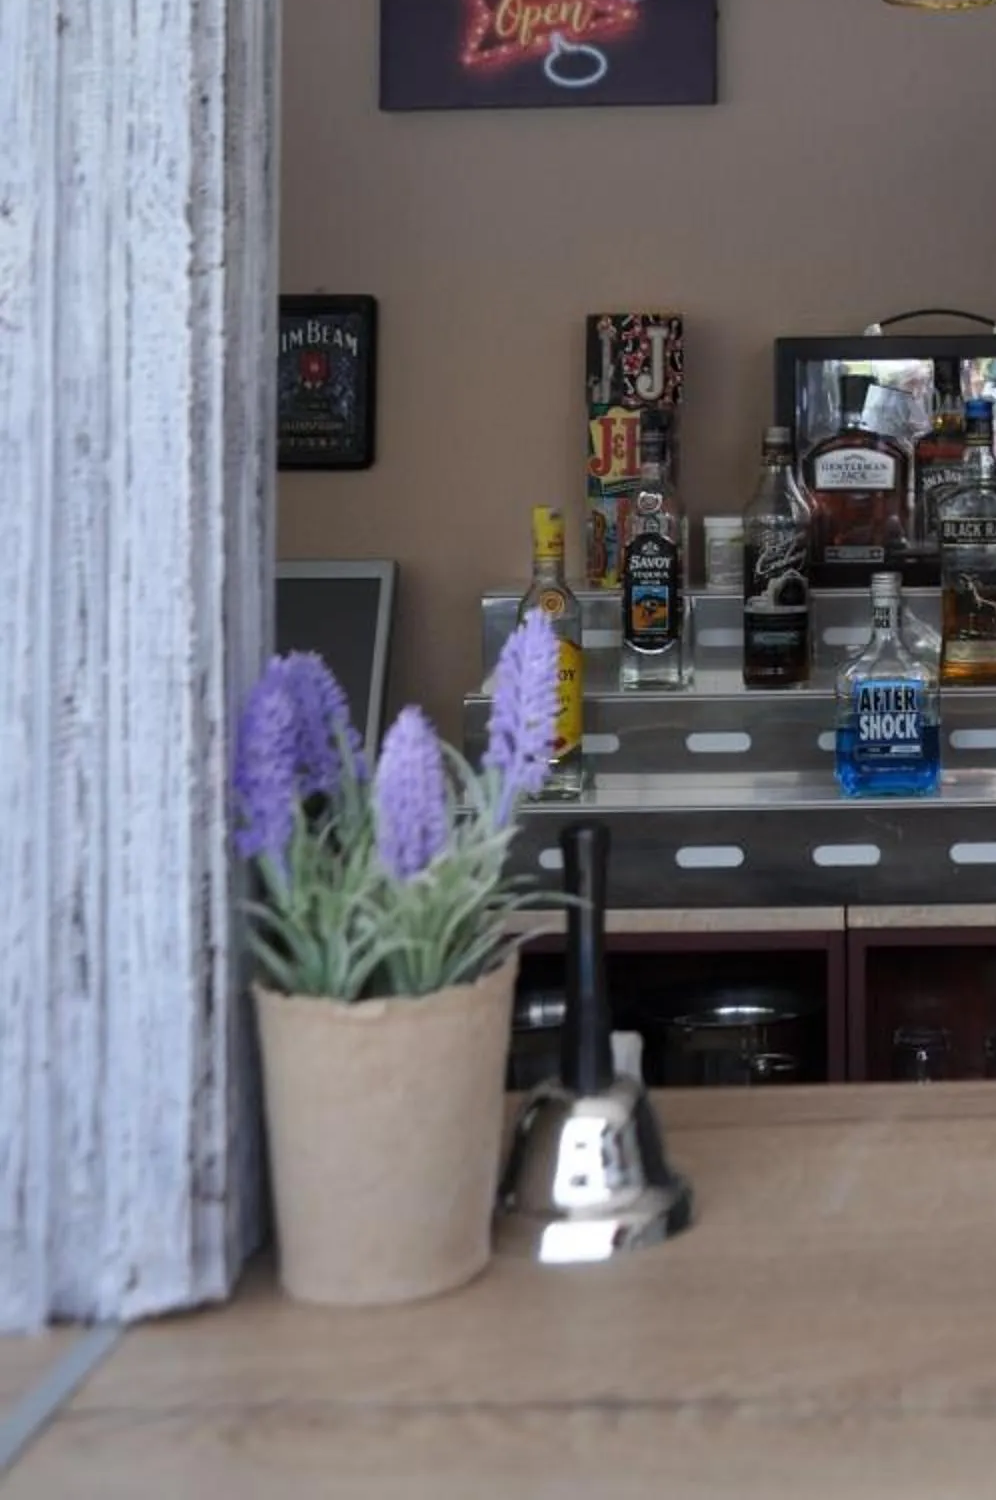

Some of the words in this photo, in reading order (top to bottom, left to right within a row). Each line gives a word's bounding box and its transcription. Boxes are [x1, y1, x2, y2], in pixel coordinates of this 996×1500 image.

[281, 328, 304, 353] IM
[943, 522, 981, 537] BLACK
[630, 555, 671, 570] SAVOY
[860, 687, 917, 712] AFTER
[859, 713, 919, 741] SHOCK
